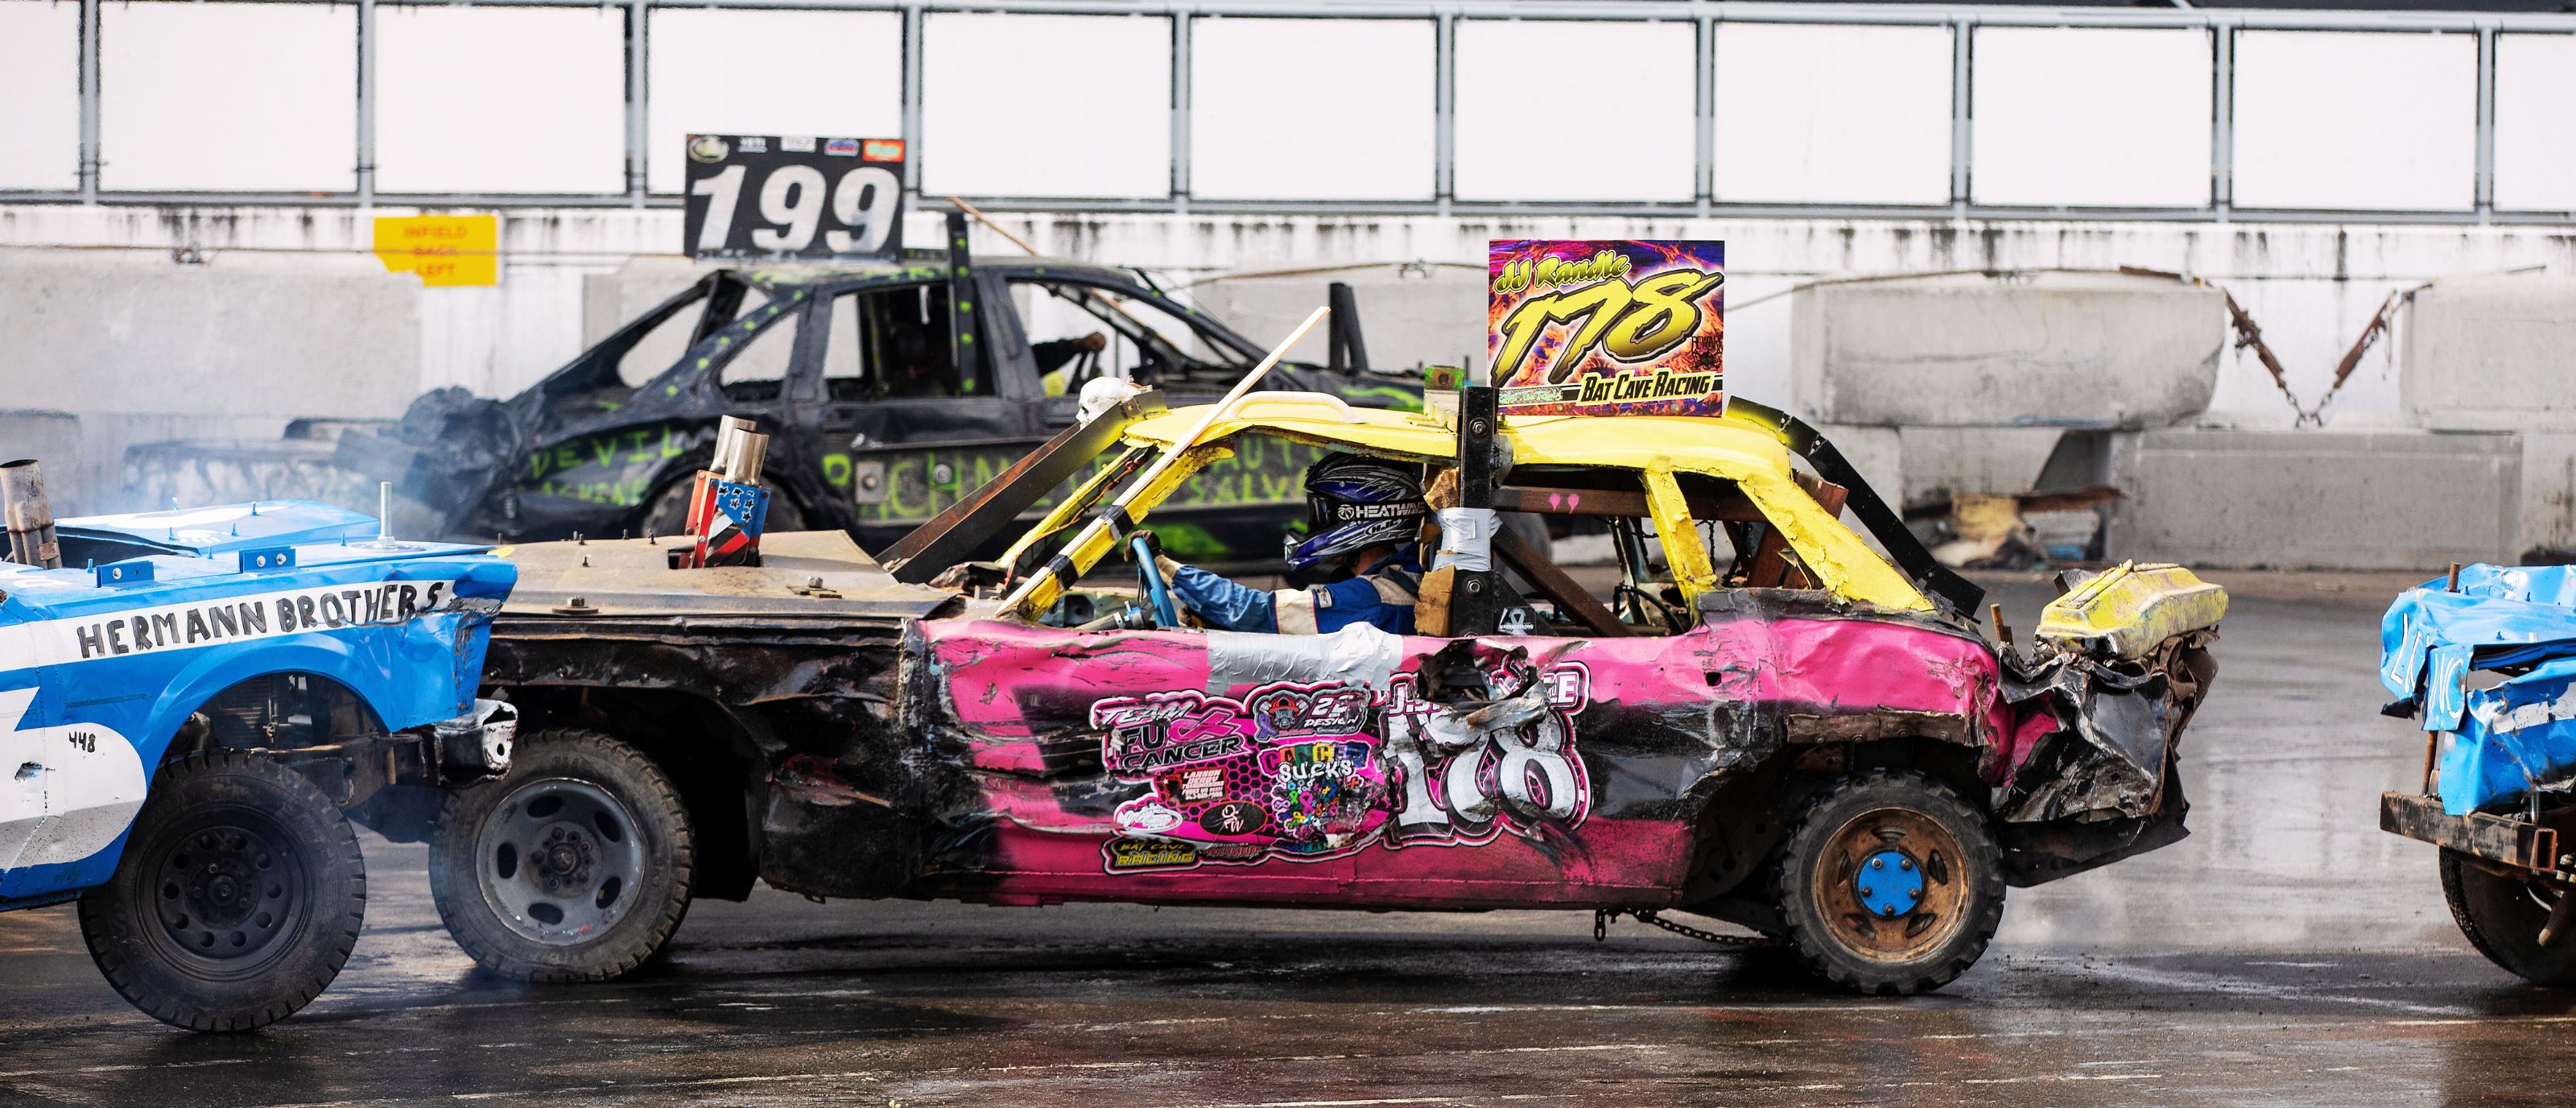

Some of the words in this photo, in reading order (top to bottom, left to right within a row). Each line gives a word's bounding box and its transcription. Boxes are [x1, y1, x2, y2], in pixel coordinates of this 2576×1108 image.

[691, 164, 901, 254] 199
[403, 224, 469, 239] INFIELD
[415, 263, 456, 277] LEFT
[1495, 259, 1530, 292] JJ
[1536, 250, 1632, 288] Randle
[1490, 269, 1724, 387] 178
[1583, 376, 1615, 401] BAT
[1613, 374, 1653, 400] CAVE
[1657, 370, 1712, 399] RACING
[530, 424, 683, 480] DEVIL
[1356, 502, 1426, 519] HEATWAVE
[76, 601, 267, 659] HERMANN
[275, 581, 445, 632] BROTHERS
[1103, 701, 1195, 725] TEAM
[1304, 713, 1359, 728] DESIGN
[68, 730, 96, 753] 448
[1122, 736, 1241, 769] CANCER
[1261, 744, 1367, 773] CANCER
[1183, 770, 1221, 779] LARSON
[1278, 759, 1354, 783] SUCKS
[1117, 853, 1193, 866] RACING
